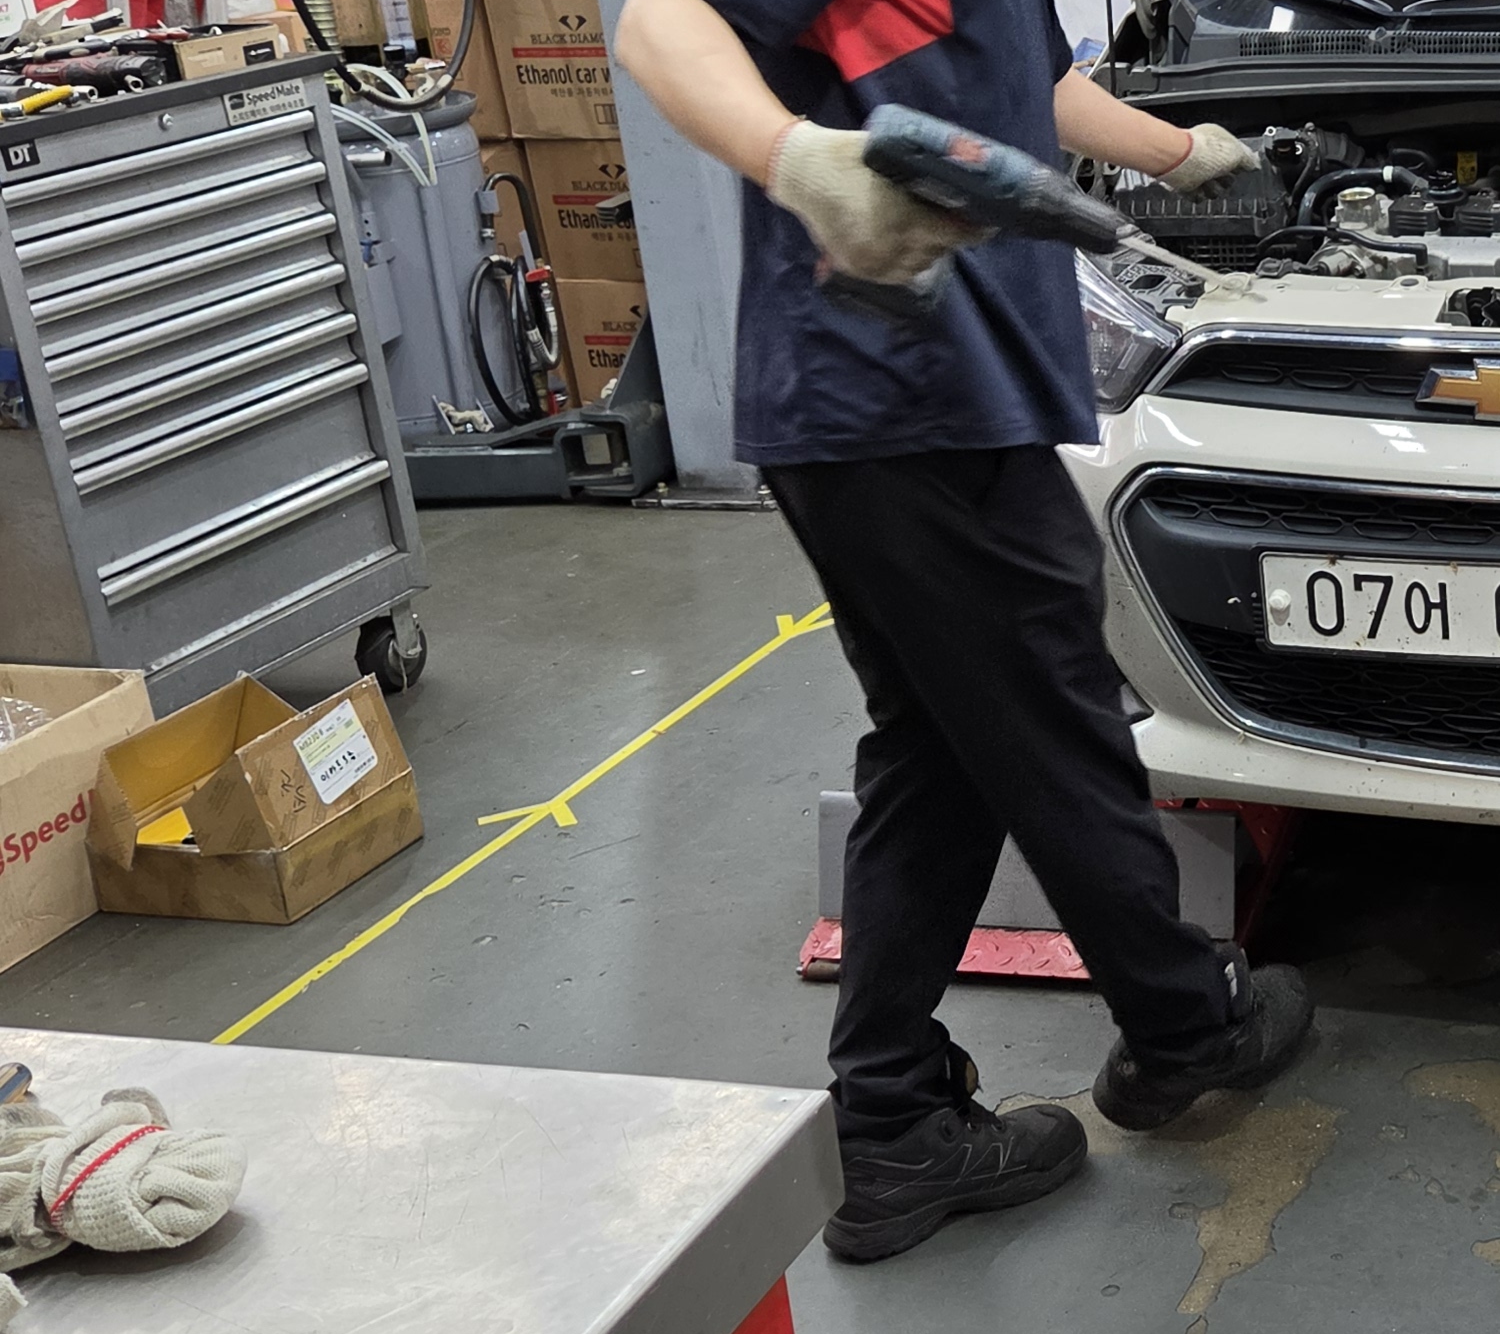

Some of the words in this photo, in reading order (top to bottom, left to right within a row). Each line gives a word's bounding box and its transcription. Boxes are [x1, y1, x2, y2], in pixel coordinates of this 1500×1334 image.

[530, 33, 566, 45] BLACK
[515, 64, 573, 85] Ethanol
[576, 66, 598, 84] car
[571, 180, 606, 192] BLACK
[608, 180, 630, 192] DIA
[602, 321, 638, 332] BLACK
[1305, 569, 1450, 641] 07어
